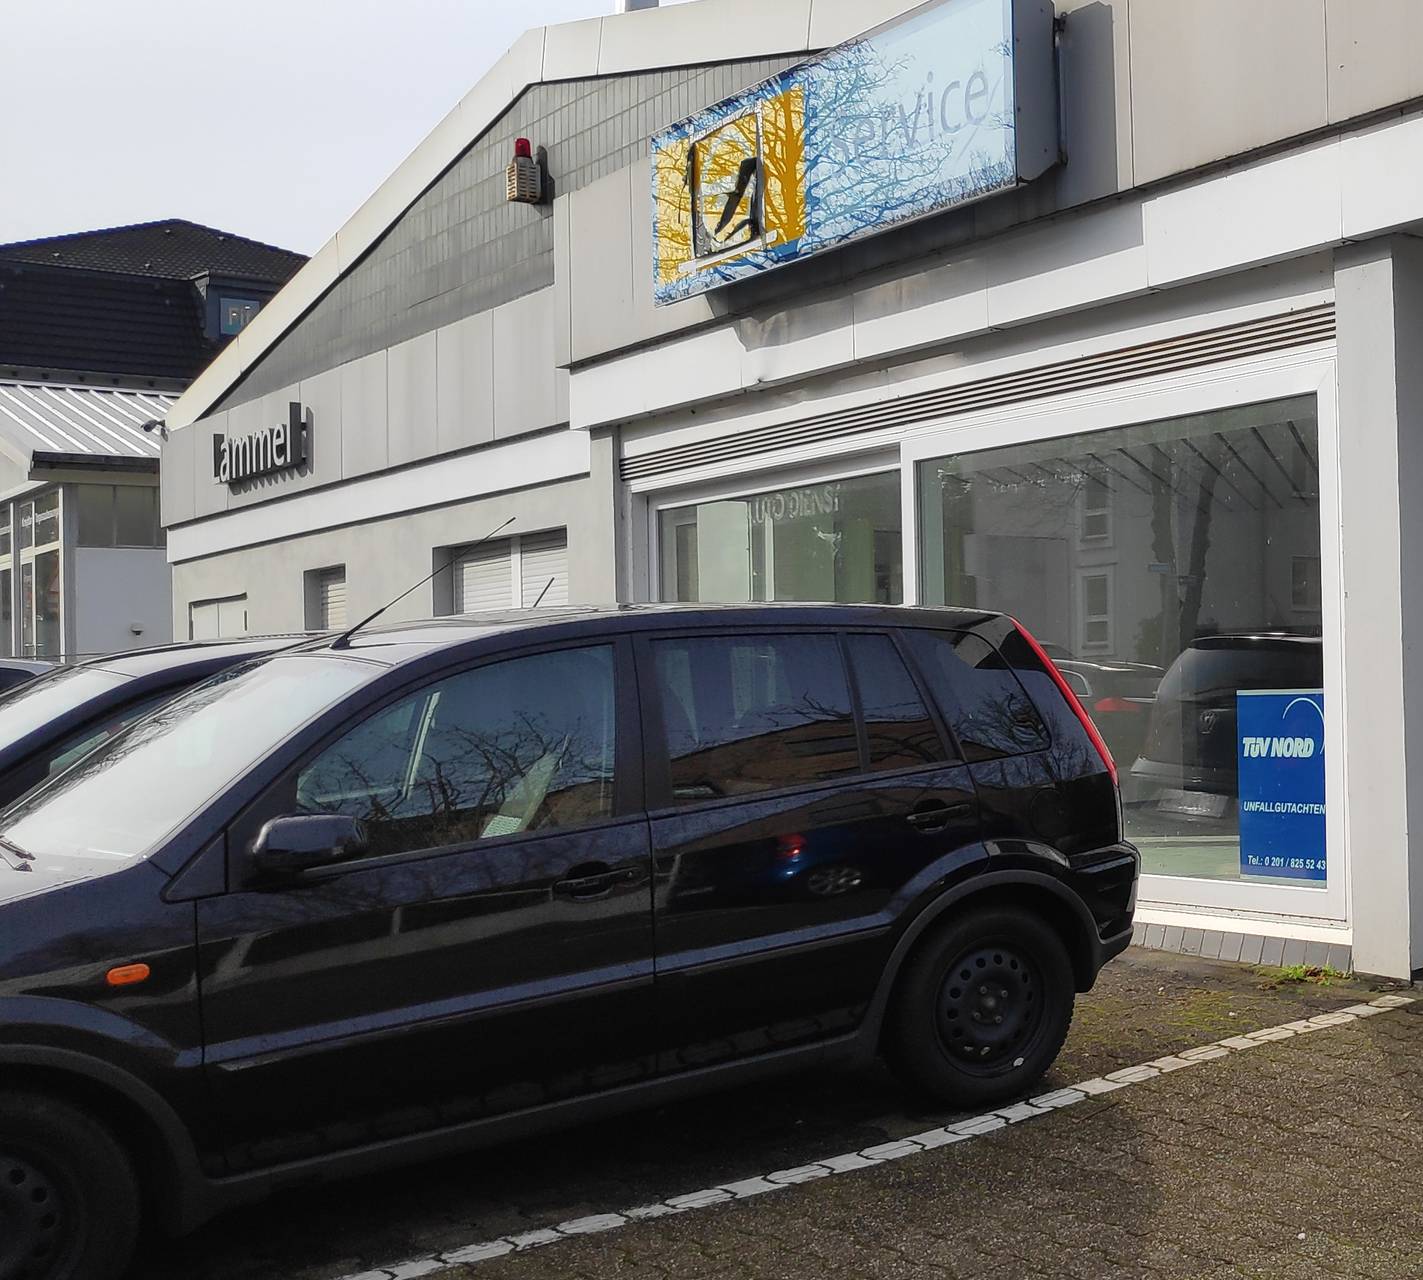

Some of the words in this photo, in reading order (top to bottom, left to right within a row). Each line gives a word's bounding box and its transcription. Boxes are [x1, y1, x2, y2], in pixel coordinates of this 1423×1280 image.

[211, 402, 302, 485] Lammel
[1243, 737, 1271, 757] TÜV
[1270, 737, 1314, 757] NORD
[1243, 801, 1326, 814] UNFALLGUTACHTEN
[1248, 855, 1263, 865] Tel.:
[1271, 857, 1283, 867] 201
[1290, 858, 1304, 868] 825
[1305, 859, 1315, 869] 52
[1316, 860, 1326, 870] 43
